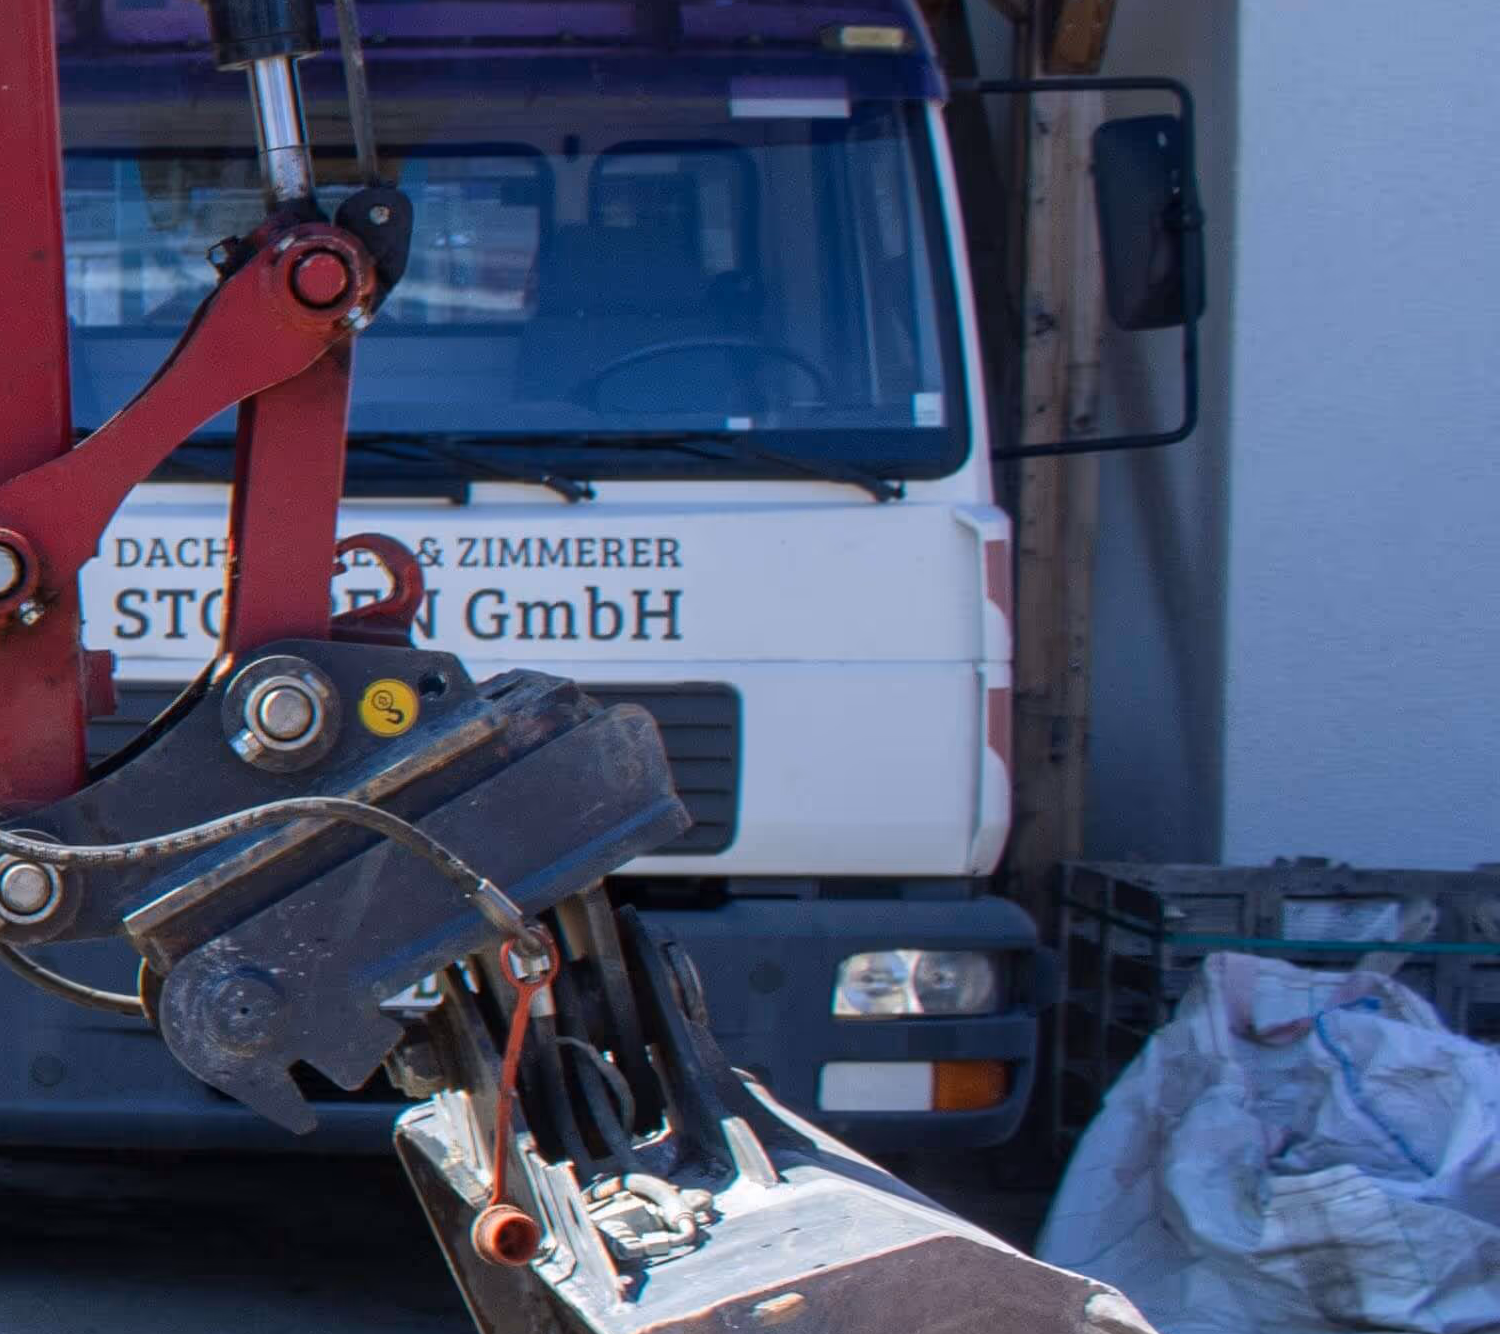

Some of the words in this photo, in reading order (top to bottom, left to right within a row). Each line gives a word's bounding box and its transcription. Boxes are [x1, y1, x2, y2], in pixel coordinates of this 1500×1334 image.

[417, 537, 445, 568] &
[457, 536, 682, 568] ZIMMERER
[463, 584, 684, 641] GmbH
